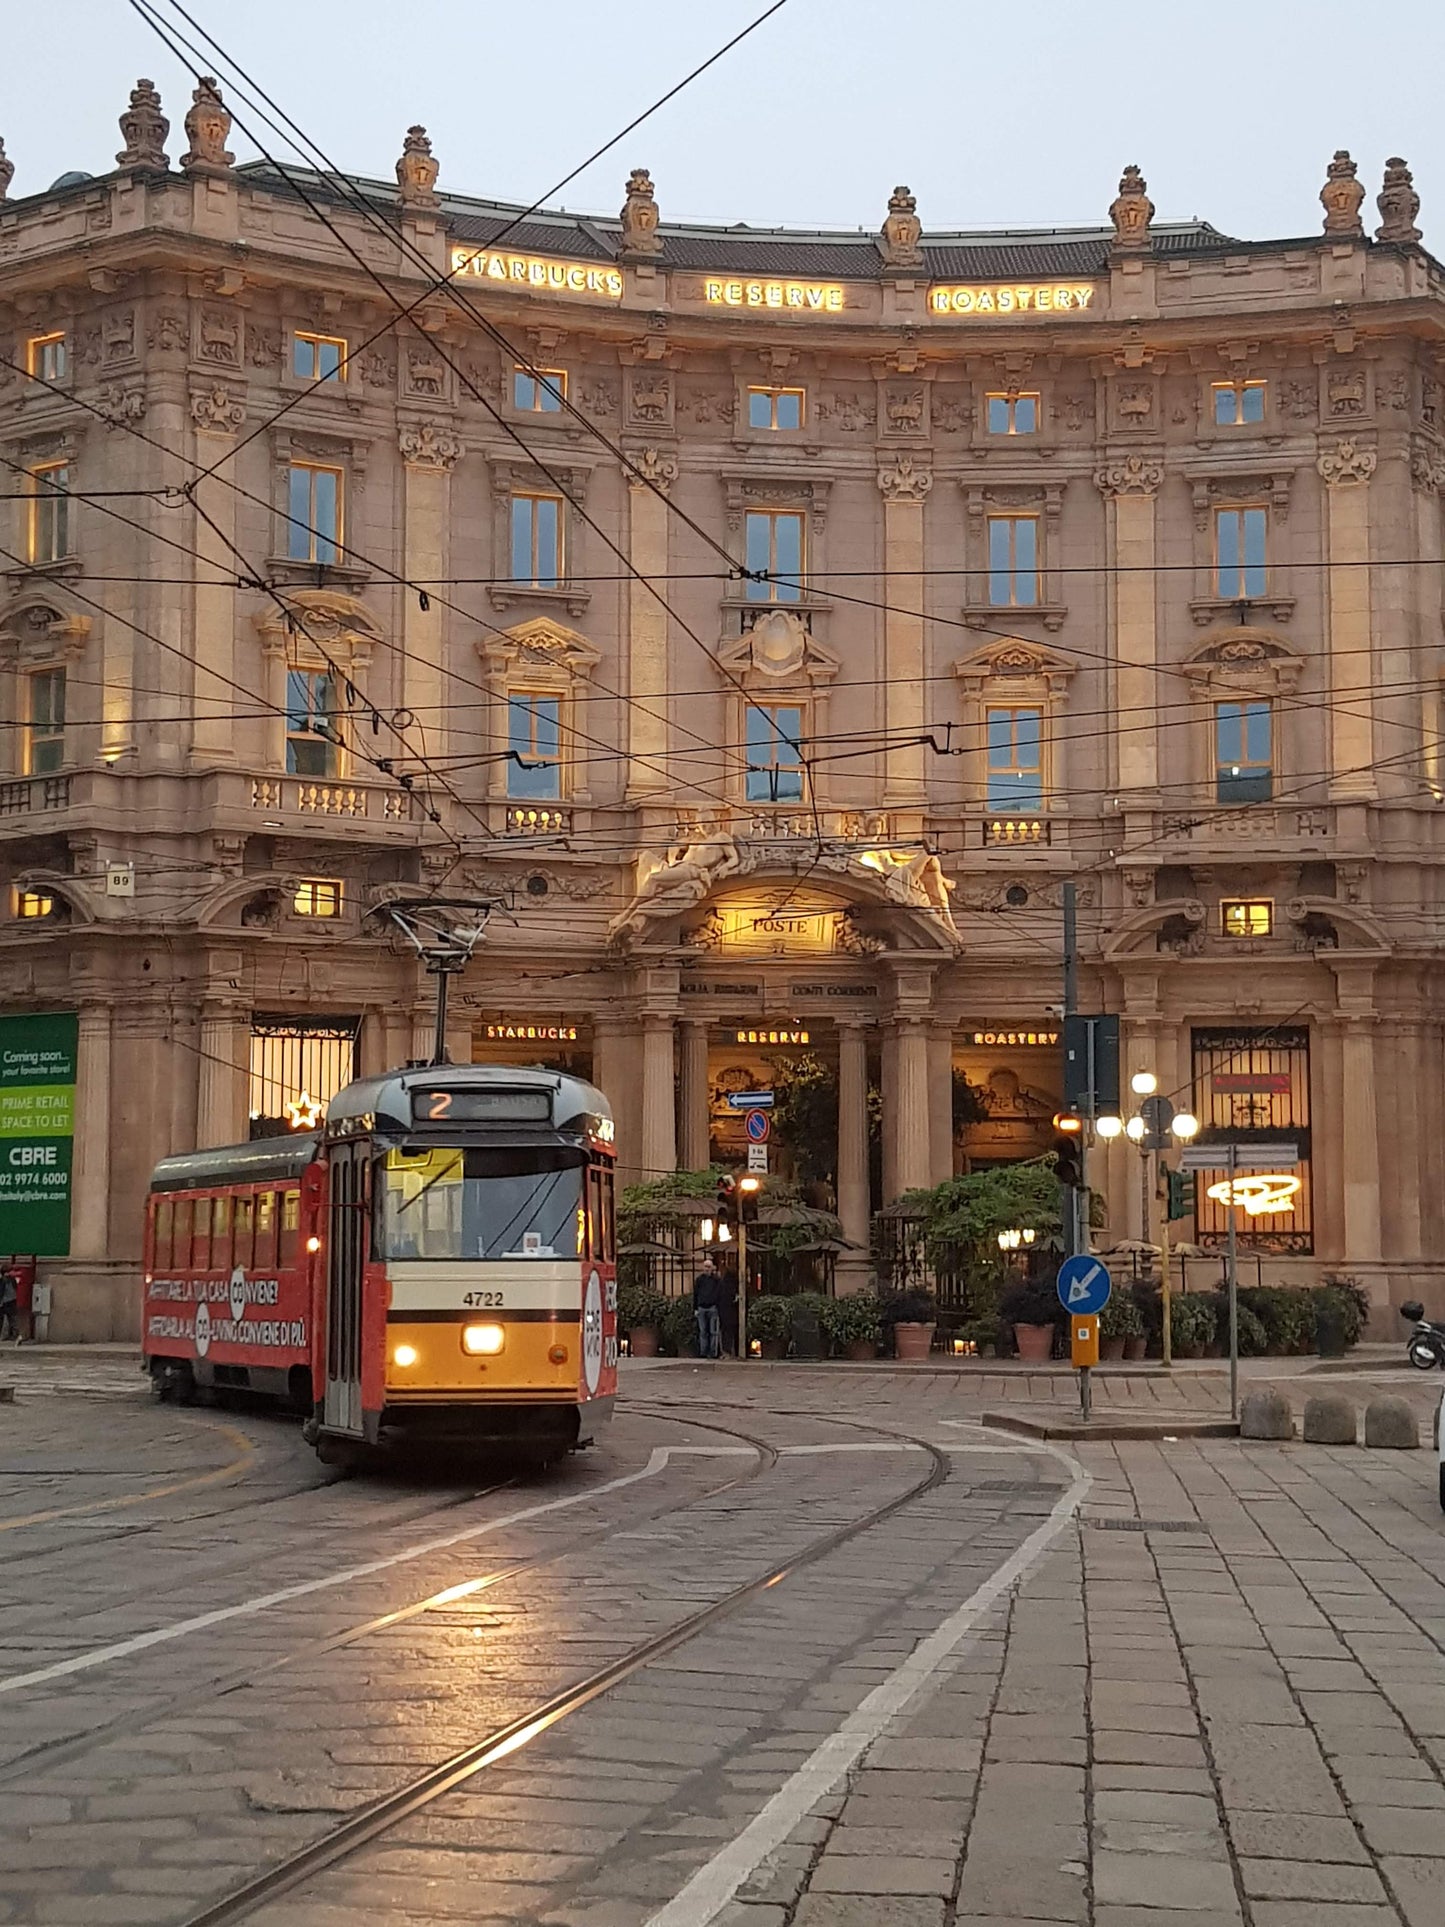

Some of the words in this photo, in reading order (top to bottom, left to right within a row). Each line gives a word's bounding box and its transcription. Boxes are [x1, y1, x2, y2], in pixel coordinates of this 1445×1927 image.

[455, 252, 622, 292] STARBUCKS
[706, 282, 842, 309] RESERVE
[935, 287, 1092, 311] ROASTERY
[753, 918, 808, 933] POSTE
[487, 1026, 577, 1039] STARBUCKS
[737, 1031, 810, 1044] RESERVE
[974, 1033, 1058, 1045] ROASTERY
[3, 1050, 38, 1064] Coming
[2, 1096, 33, 1110] PRIME
[36, 1095, 69, 1109] RETAIL
[429, 1093, 452, 1119] 2
[2, 1115, 33, 1129] SPACE
[35, 1114, 50, 1128] TO
[52, 1114, 70, 1128] LET
[9, 1146, 57, 1166] CBRE
[0, 1173, 12, 1186] 02
[14, 1172, 40, 1186] 9974
[42, 1172, 68, 1185] 6000
[208, 1280, 229, 1303] CASA
[463, 1292, 504, 1307] 4722
[237, 1320, 281, 1346] CONVIENE
